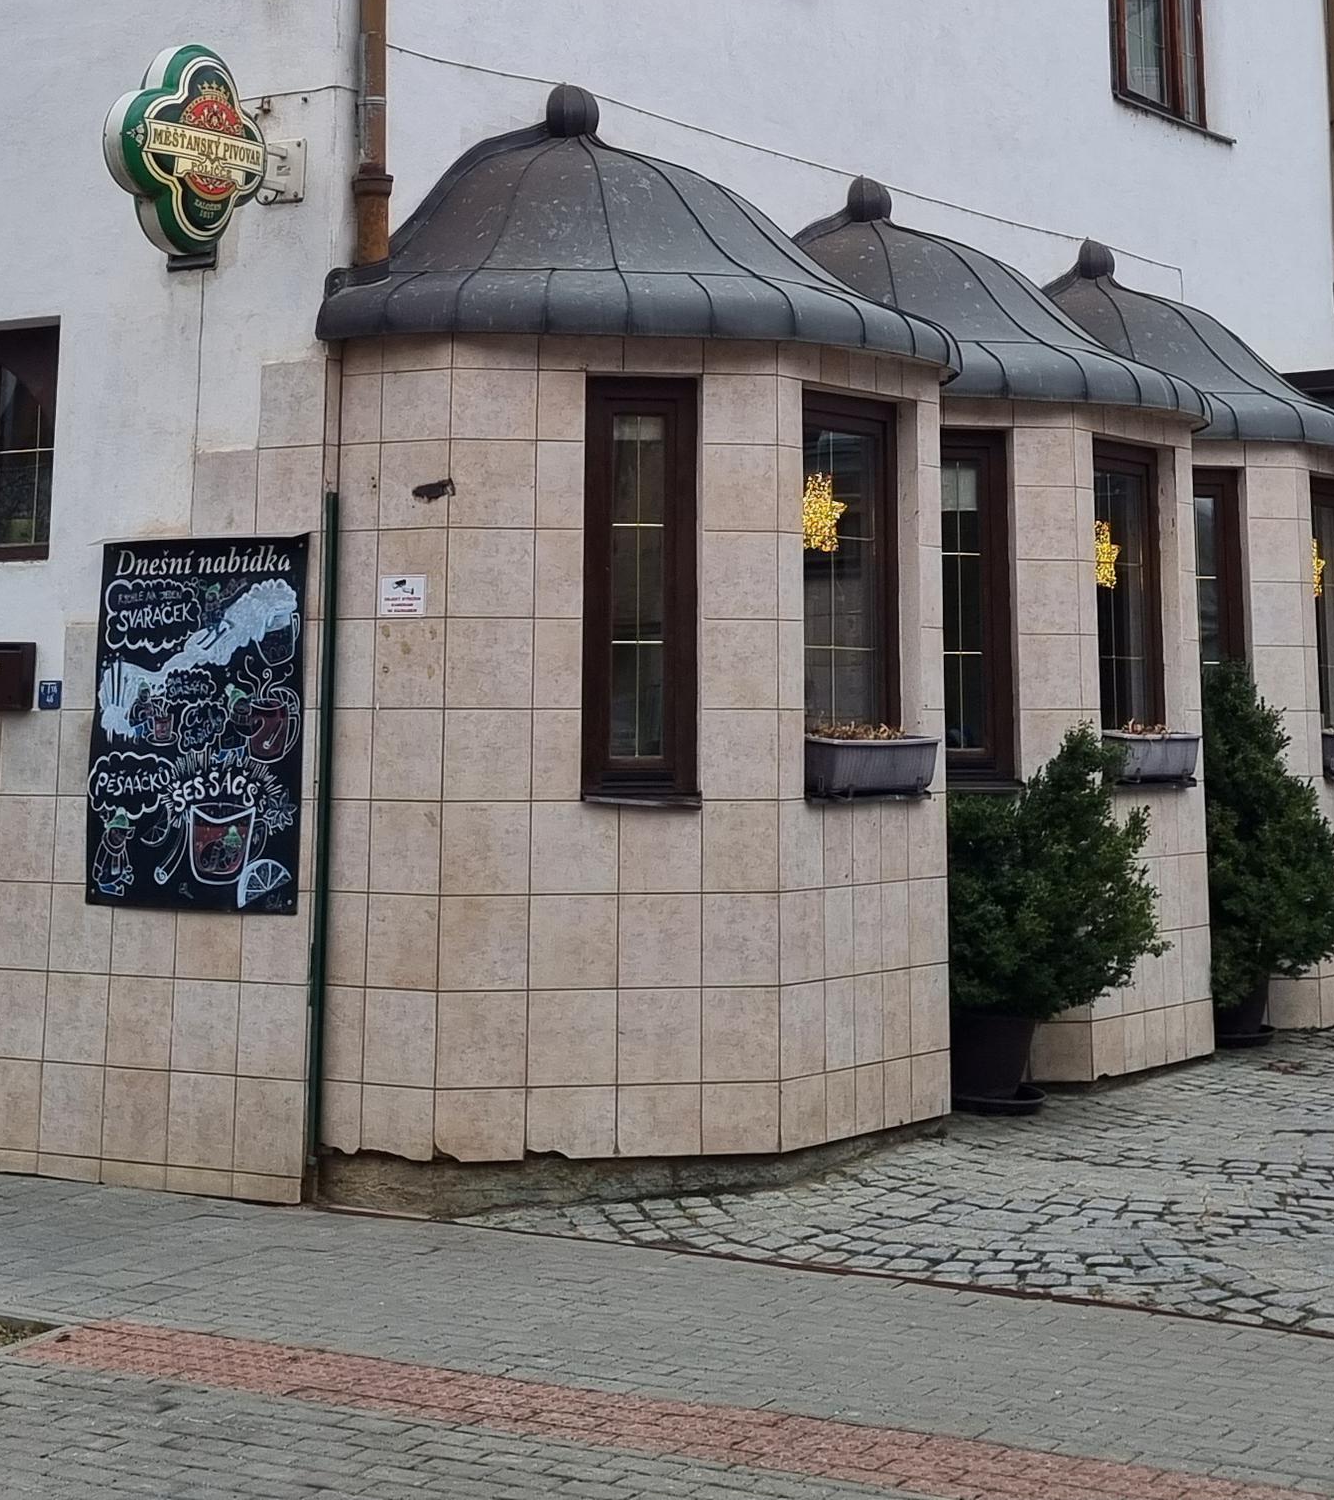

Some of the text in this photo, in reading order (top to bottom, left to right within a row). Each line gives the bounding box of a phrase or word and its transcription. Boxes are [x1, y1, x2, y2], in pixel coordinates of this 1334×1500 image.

[153, 127, 261, 166] MĚŠŤANSKÝ PIVOVAR
[115, 544, 292, 577] Dnešní nabídka
[117, 602, 196, 632] SVAŘÁČEK
